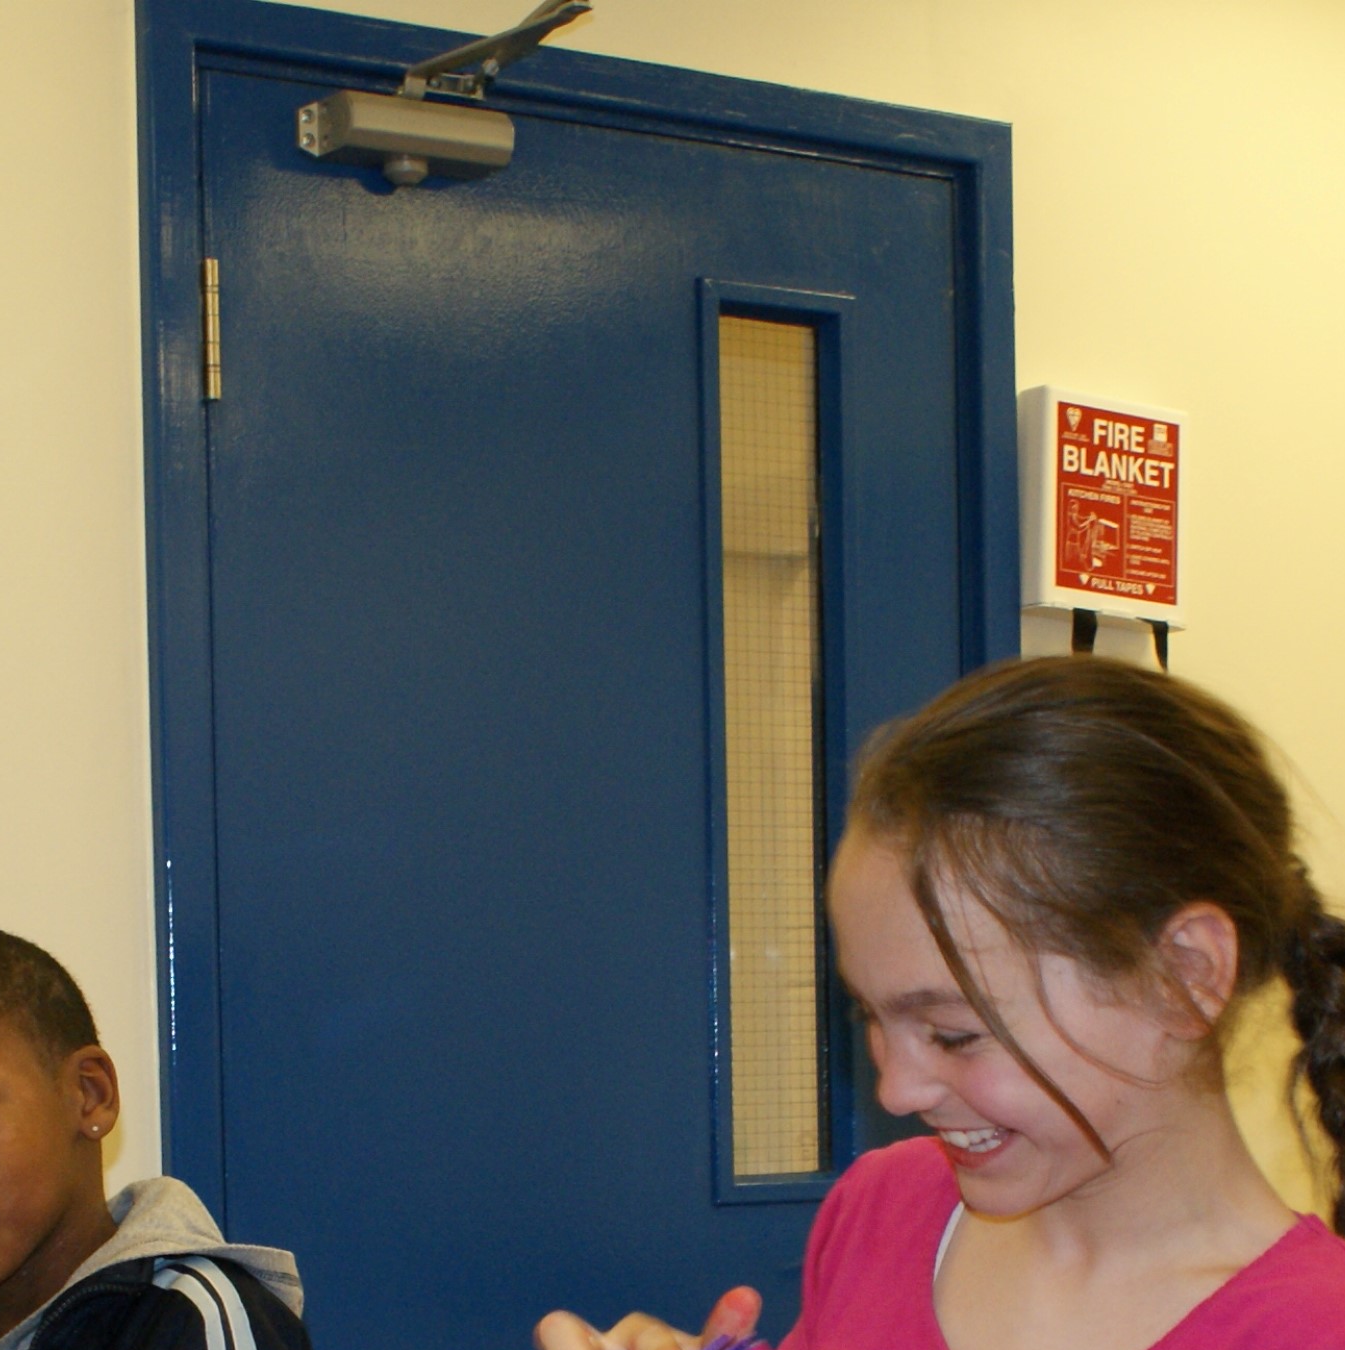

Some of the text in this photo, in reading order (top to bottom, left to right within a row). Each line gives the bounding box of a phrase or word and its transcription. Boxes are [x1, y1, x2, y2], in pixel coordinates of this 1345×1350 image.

[1093, 418, 1146, 454] FIRE
[1062, 444, 1175, 489] BLANKET
[1091, 577, 1144, 596] PULL TAPES
